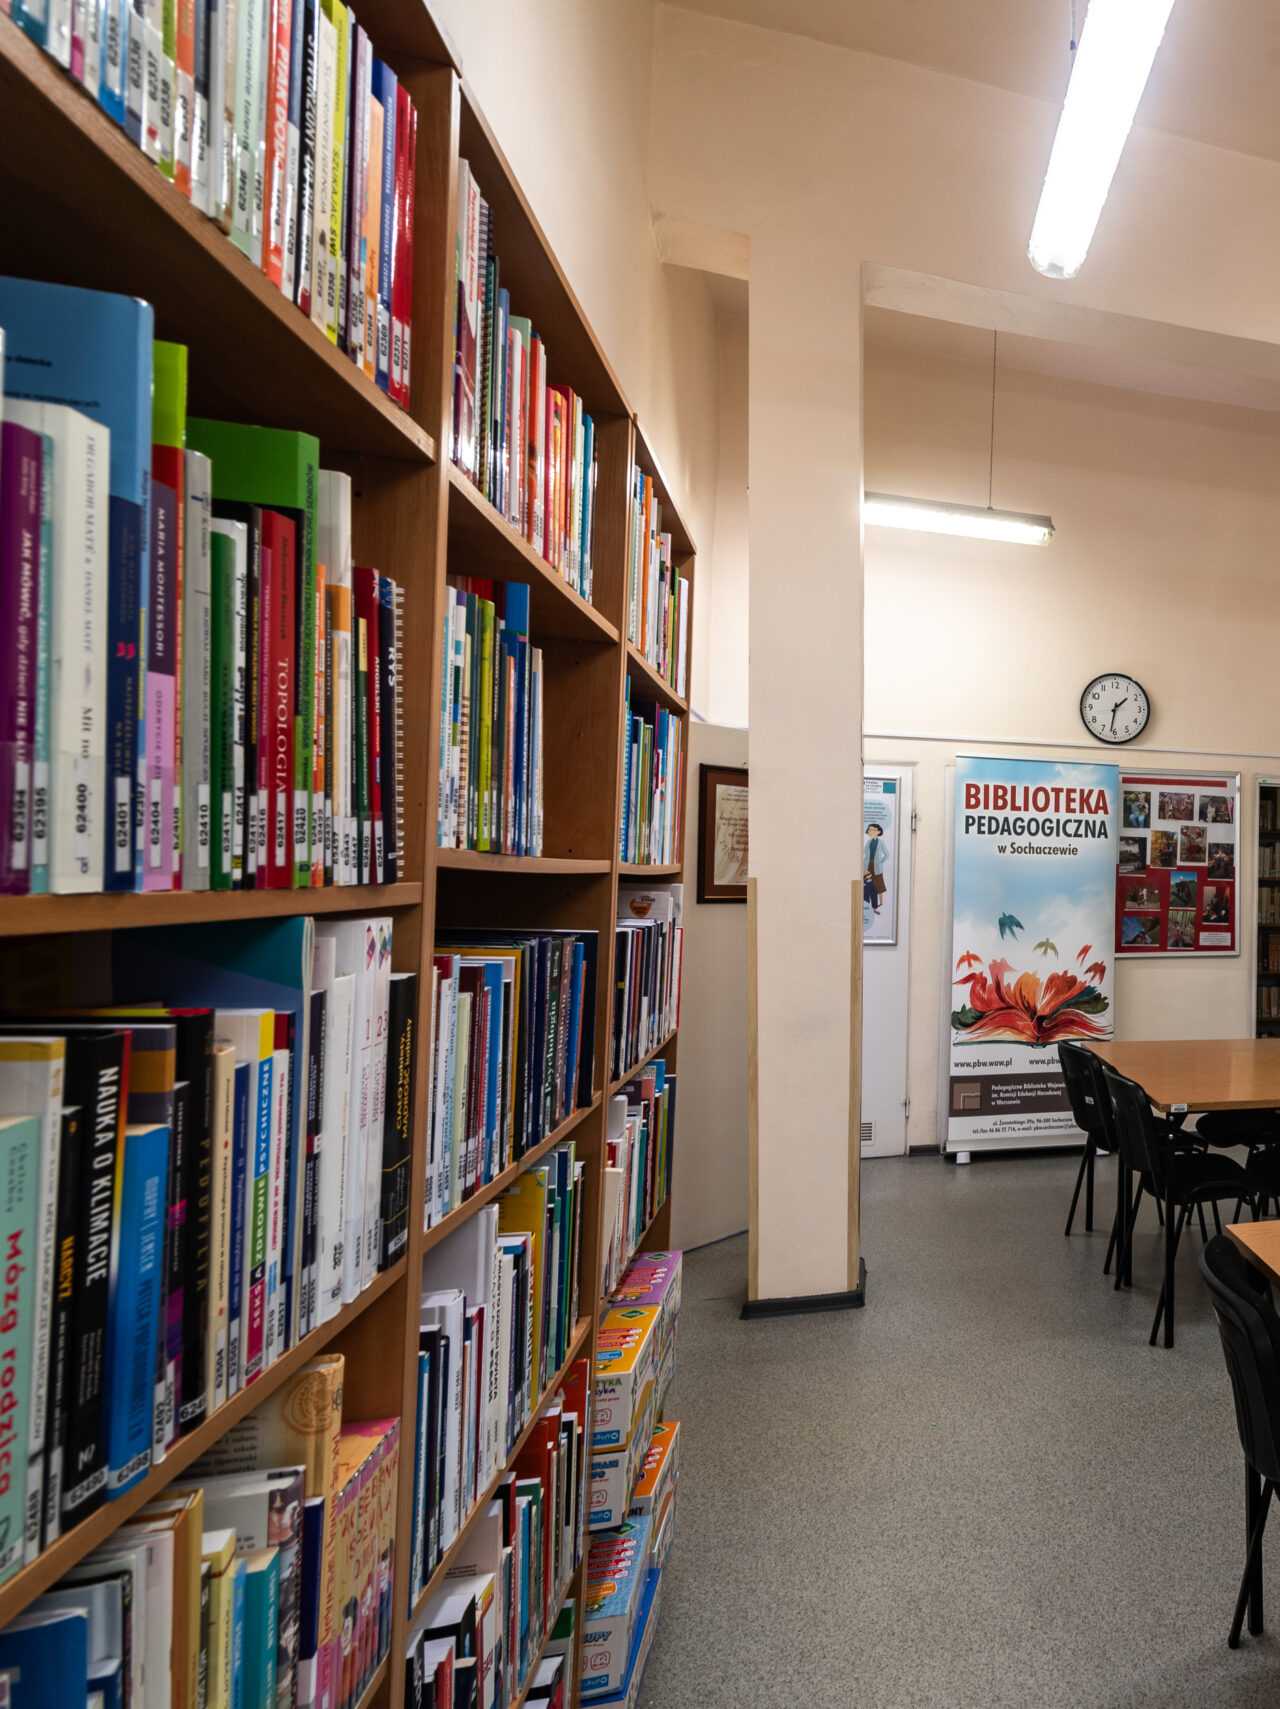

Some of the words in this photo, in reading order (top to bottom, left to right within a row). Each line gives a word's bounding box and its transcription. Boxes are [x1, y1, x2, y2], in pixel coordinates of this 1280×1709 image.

[130, 39, 141, 89] 62336
[147, 51, 158, 101] 62337
[276, 44, 290, 103] PTAK
[238, 169, 248, 212] 62346
[20, 529, 33, 558] JAK
[156, 507, 166, 557] MARIA
[18, 561, 34, 622] MÓWIĆ,
[83, 570, 93, 616] DANIEL
[155, 560, 166, 657] MONTESSORI
[16, 624, 29, 651] gdy
[16, 653, 29, 698] dzieci
[374, 656, 382, 713] ANGIELSKI
[1091, 692, 1100, 700] 10
[1101, 684, 1106, 692] 11
[1111, 681, 1120, 690] 12
[1133, 693, 1139, 701] 2
[15, 700, 28, 727] NIE
[82, 706, 93, 732] Mit
[276, 657, 289, 794] TOPOLOGIA
[1088, 703, 1093, 711] 9
[1091, 715, 1097, 724] 8
[1101, 724, 1106, 732] 7
[1124, 725, 1130, 733] 5
[1133, 717, 1138, 725] 4
[1137, 705, 1142, 713] 3
[1112, 728, 1118, 736] 6
[13, 788, 28, 843] 62394
[33, 787, 48, 840] 62395
[75, 783, 88, 834] 62400
[235, 786, 244, 826] 62414
[964, 782, 1110, 815] BIBLIOTEKA
[118, 801, 128, 848] 62401
[150, 800, 161, 846] 62404
[199, 803, 208, 847] 62410
[258, 808, 266, 847] 62416
[277, 811, 285, 849] 62417
[964, 815, 1109, 839] PEDAGOGICZNA
[997, 844, 1007, 855] w
[1010, 841, 1079, 856] Sochaczewie
[403, 1018, 413, 1065] kobiety
[543, 1001, 558, 1095] Psychologia
[953, 1057, 1013, 1070] www.pbw.waw.pl
[1028, 1056, 1061, 1066] www.pbw
[94, 1066, 120, 1148] NAUKA
[396, 1087, 404, 1131] CIAŁO
[401, 1067, 411, 1139] MĄDROŚĆ
[991, 1084, 1023, 1092] Pedagogiczna
[1023, 1082, 1047, 1090] Biblioteka
[1017, 1089, 1037, 1097] Edukacji
[259, 1062, 271, 1174] PSYCHICZNE
[92, 1152, 114, 1170] O
[86, 1174, 113, 1287] KLIMACIE
[196, 1137, 211, 1292] PEDOFILIA
[256, 1177, 267, 1262] ZDROWIE
[0, 1229, 26, 1335] Mózg
[58, 1235, 75, 1301] NARCYZ
[252, 1284, 263, 1329] SEKS
[215, 1348, 225, 1390] 62504
[0, 1347, 19, 1497] rodzica
[155, 1401, 165, 1444] 62492
